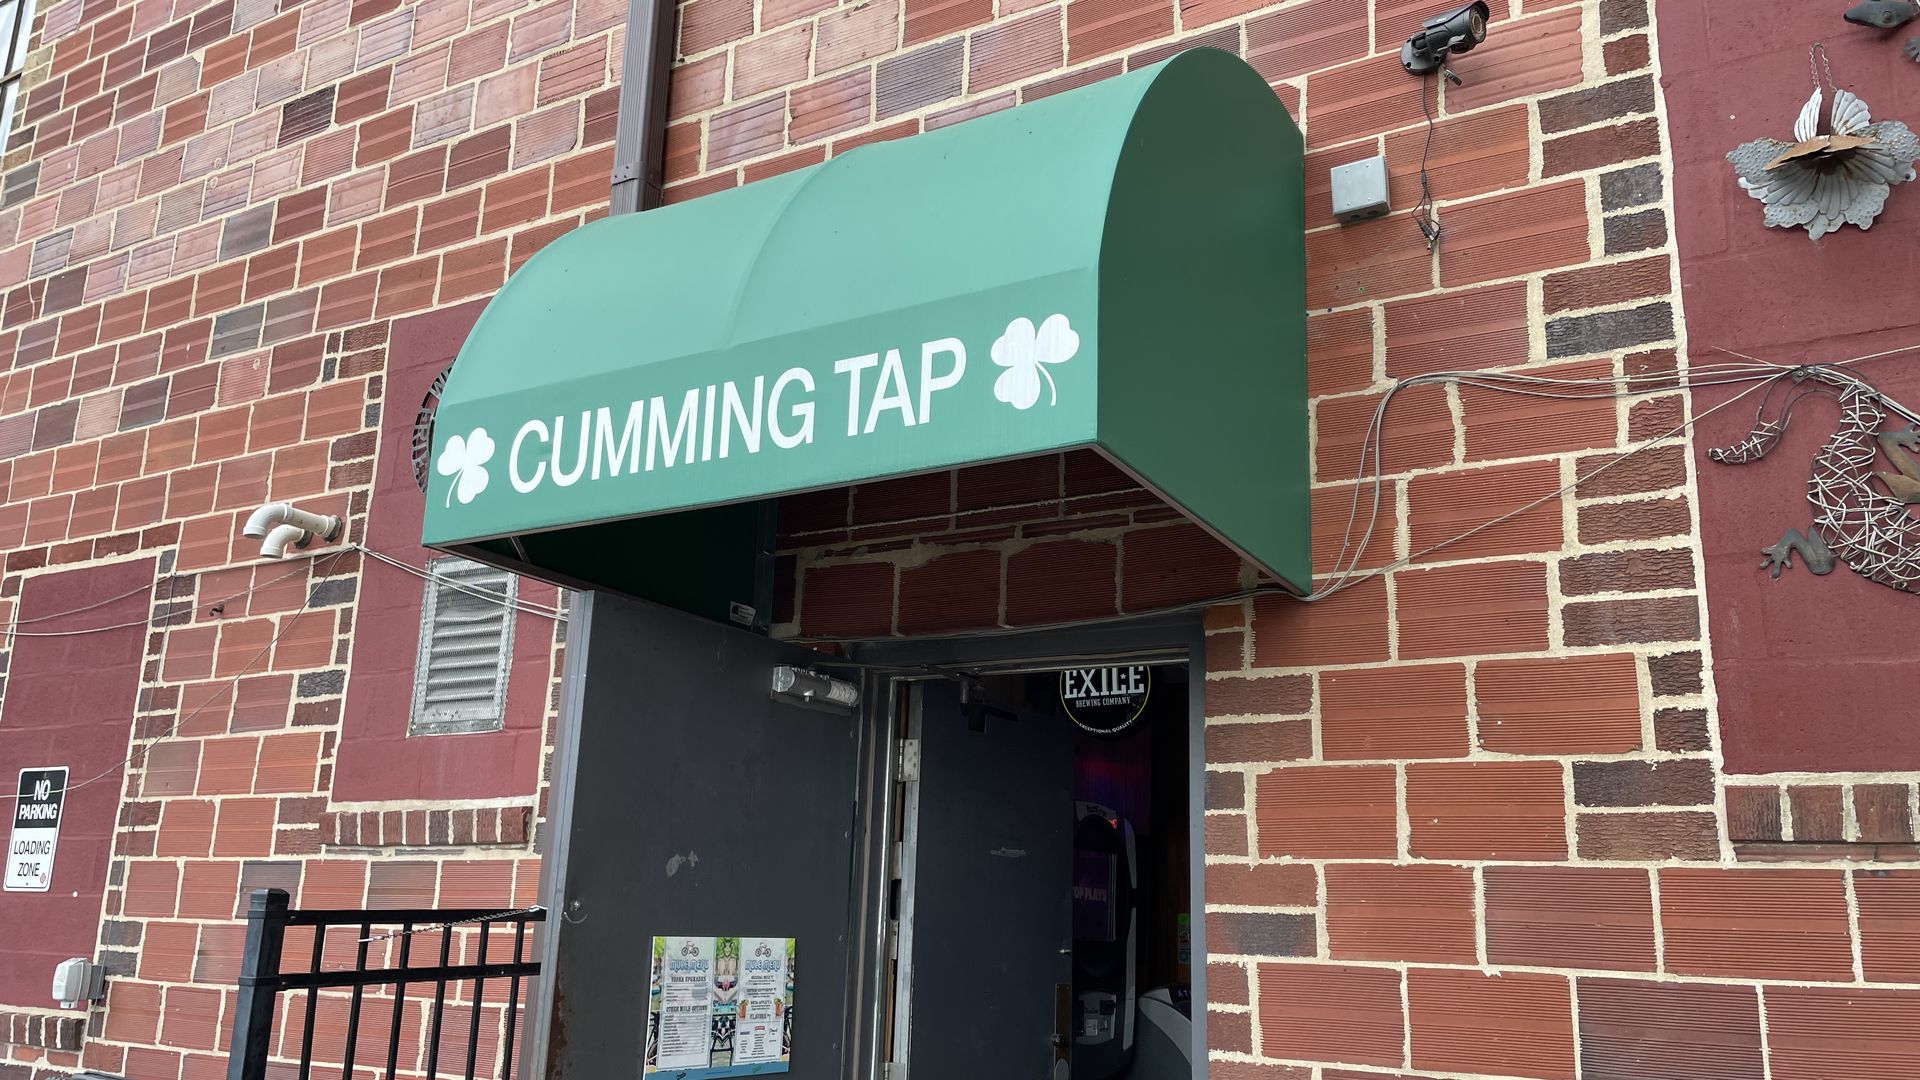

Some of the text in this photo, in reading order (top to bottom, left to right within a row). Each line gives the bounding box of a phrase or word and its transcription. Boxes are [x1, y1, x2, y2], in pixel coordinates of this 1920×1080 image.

[508, 337, 968, 495] CUMMING TAP
[1065, 667, 1144, 698] EXILE
[1076, 697, 1131, 708] BREWING COMPANY
[1112, 720, 1132, 733] QUALITY
[34, 780, 50, 800] NO
[19, 803, 57, 819] PARKING
[14, 841, 50, 854] LOADING
[18, 863, 40, 876] ZONE
[1084, 887, 1107, 903] PLAYS
[670, 959, 709, 973] MULE MENU
